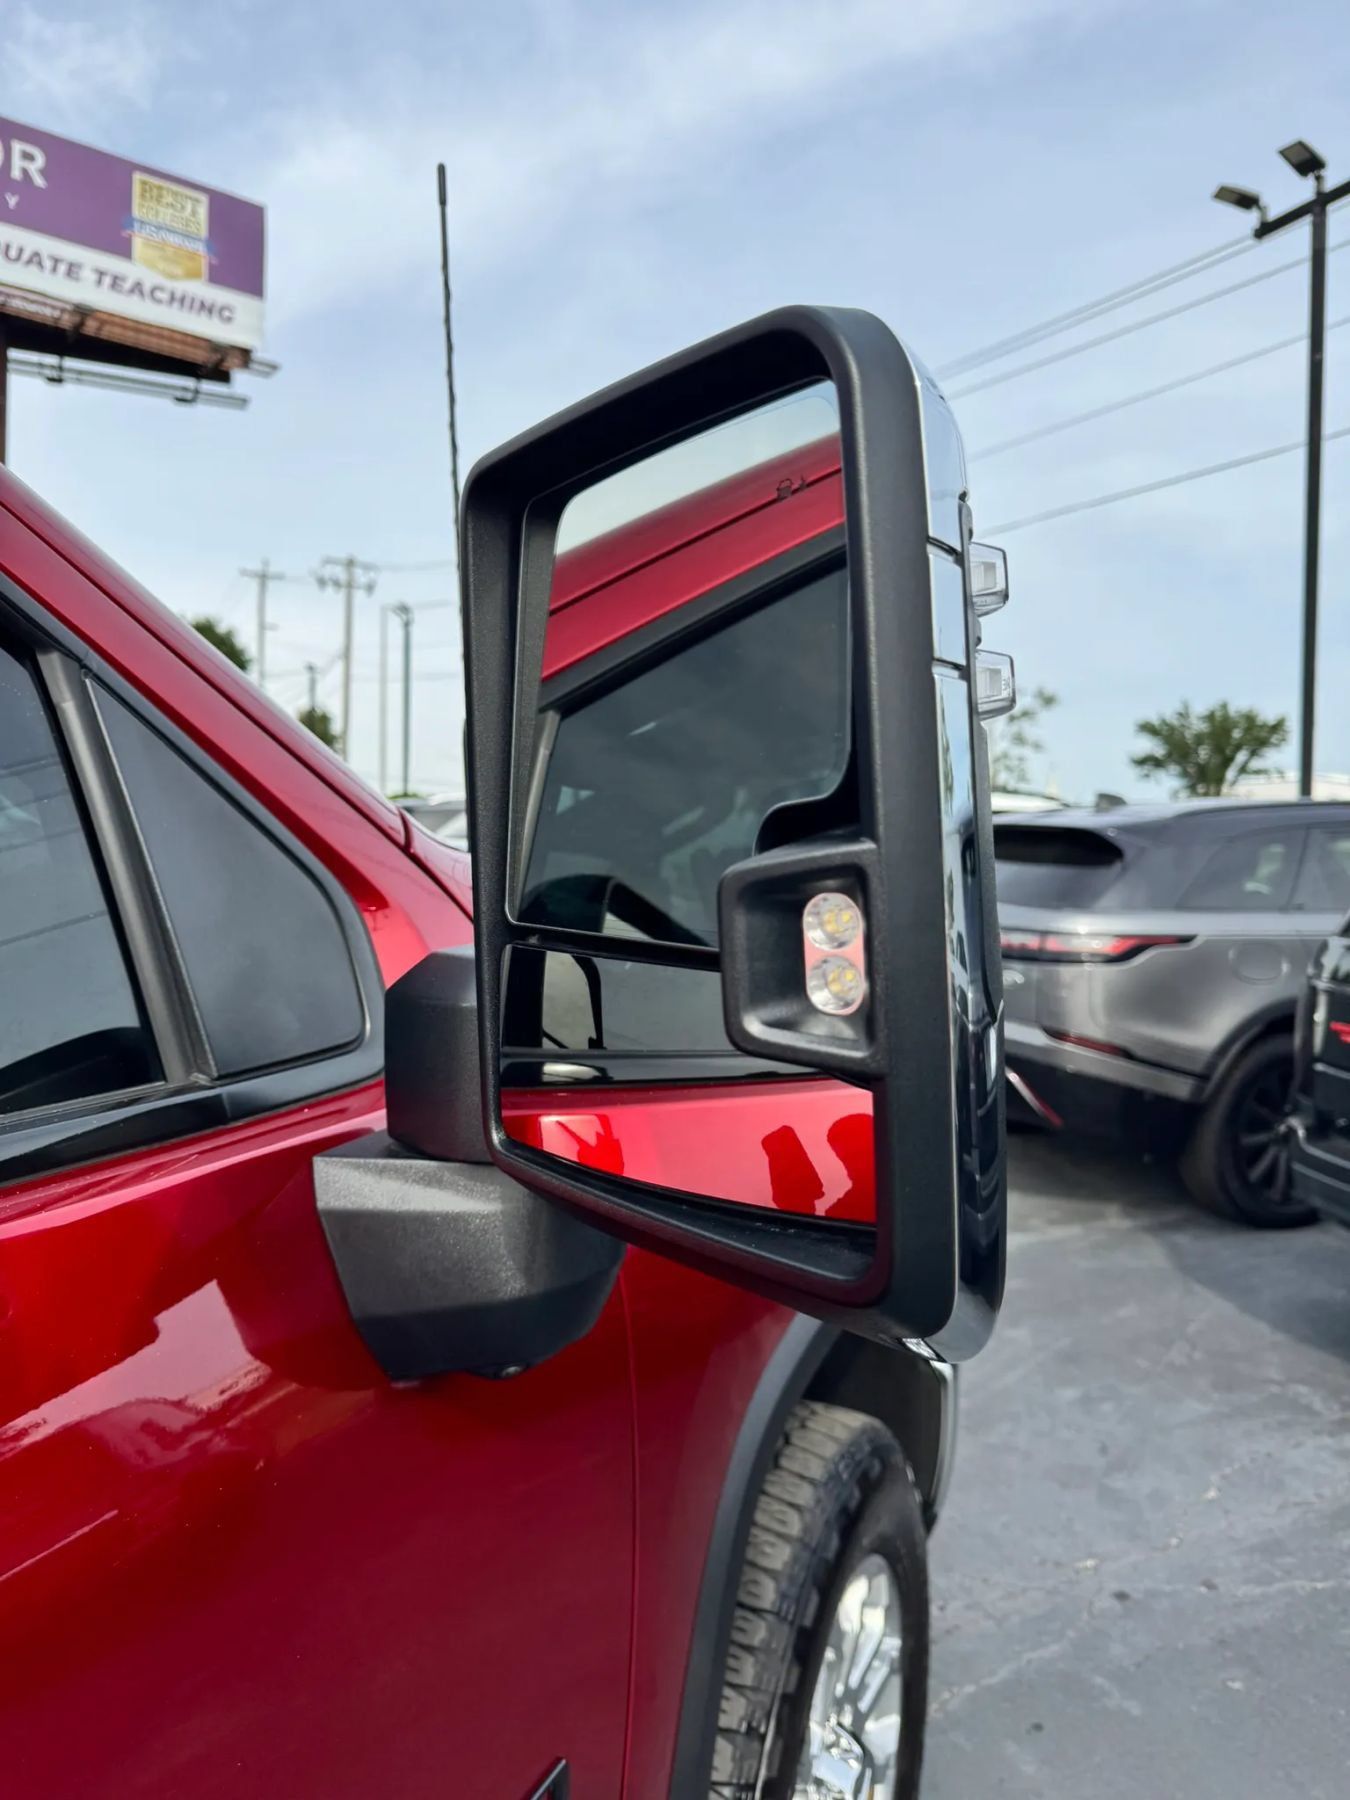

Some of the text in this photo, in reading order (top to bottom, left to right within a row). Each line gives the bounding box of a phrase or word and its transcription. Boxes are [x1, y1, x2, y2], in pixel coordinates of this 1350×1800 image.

[0, 138, 48, 189] R
[4, 243, 82, 282] UATE
[92, 268, 235, 324] TEACHING
